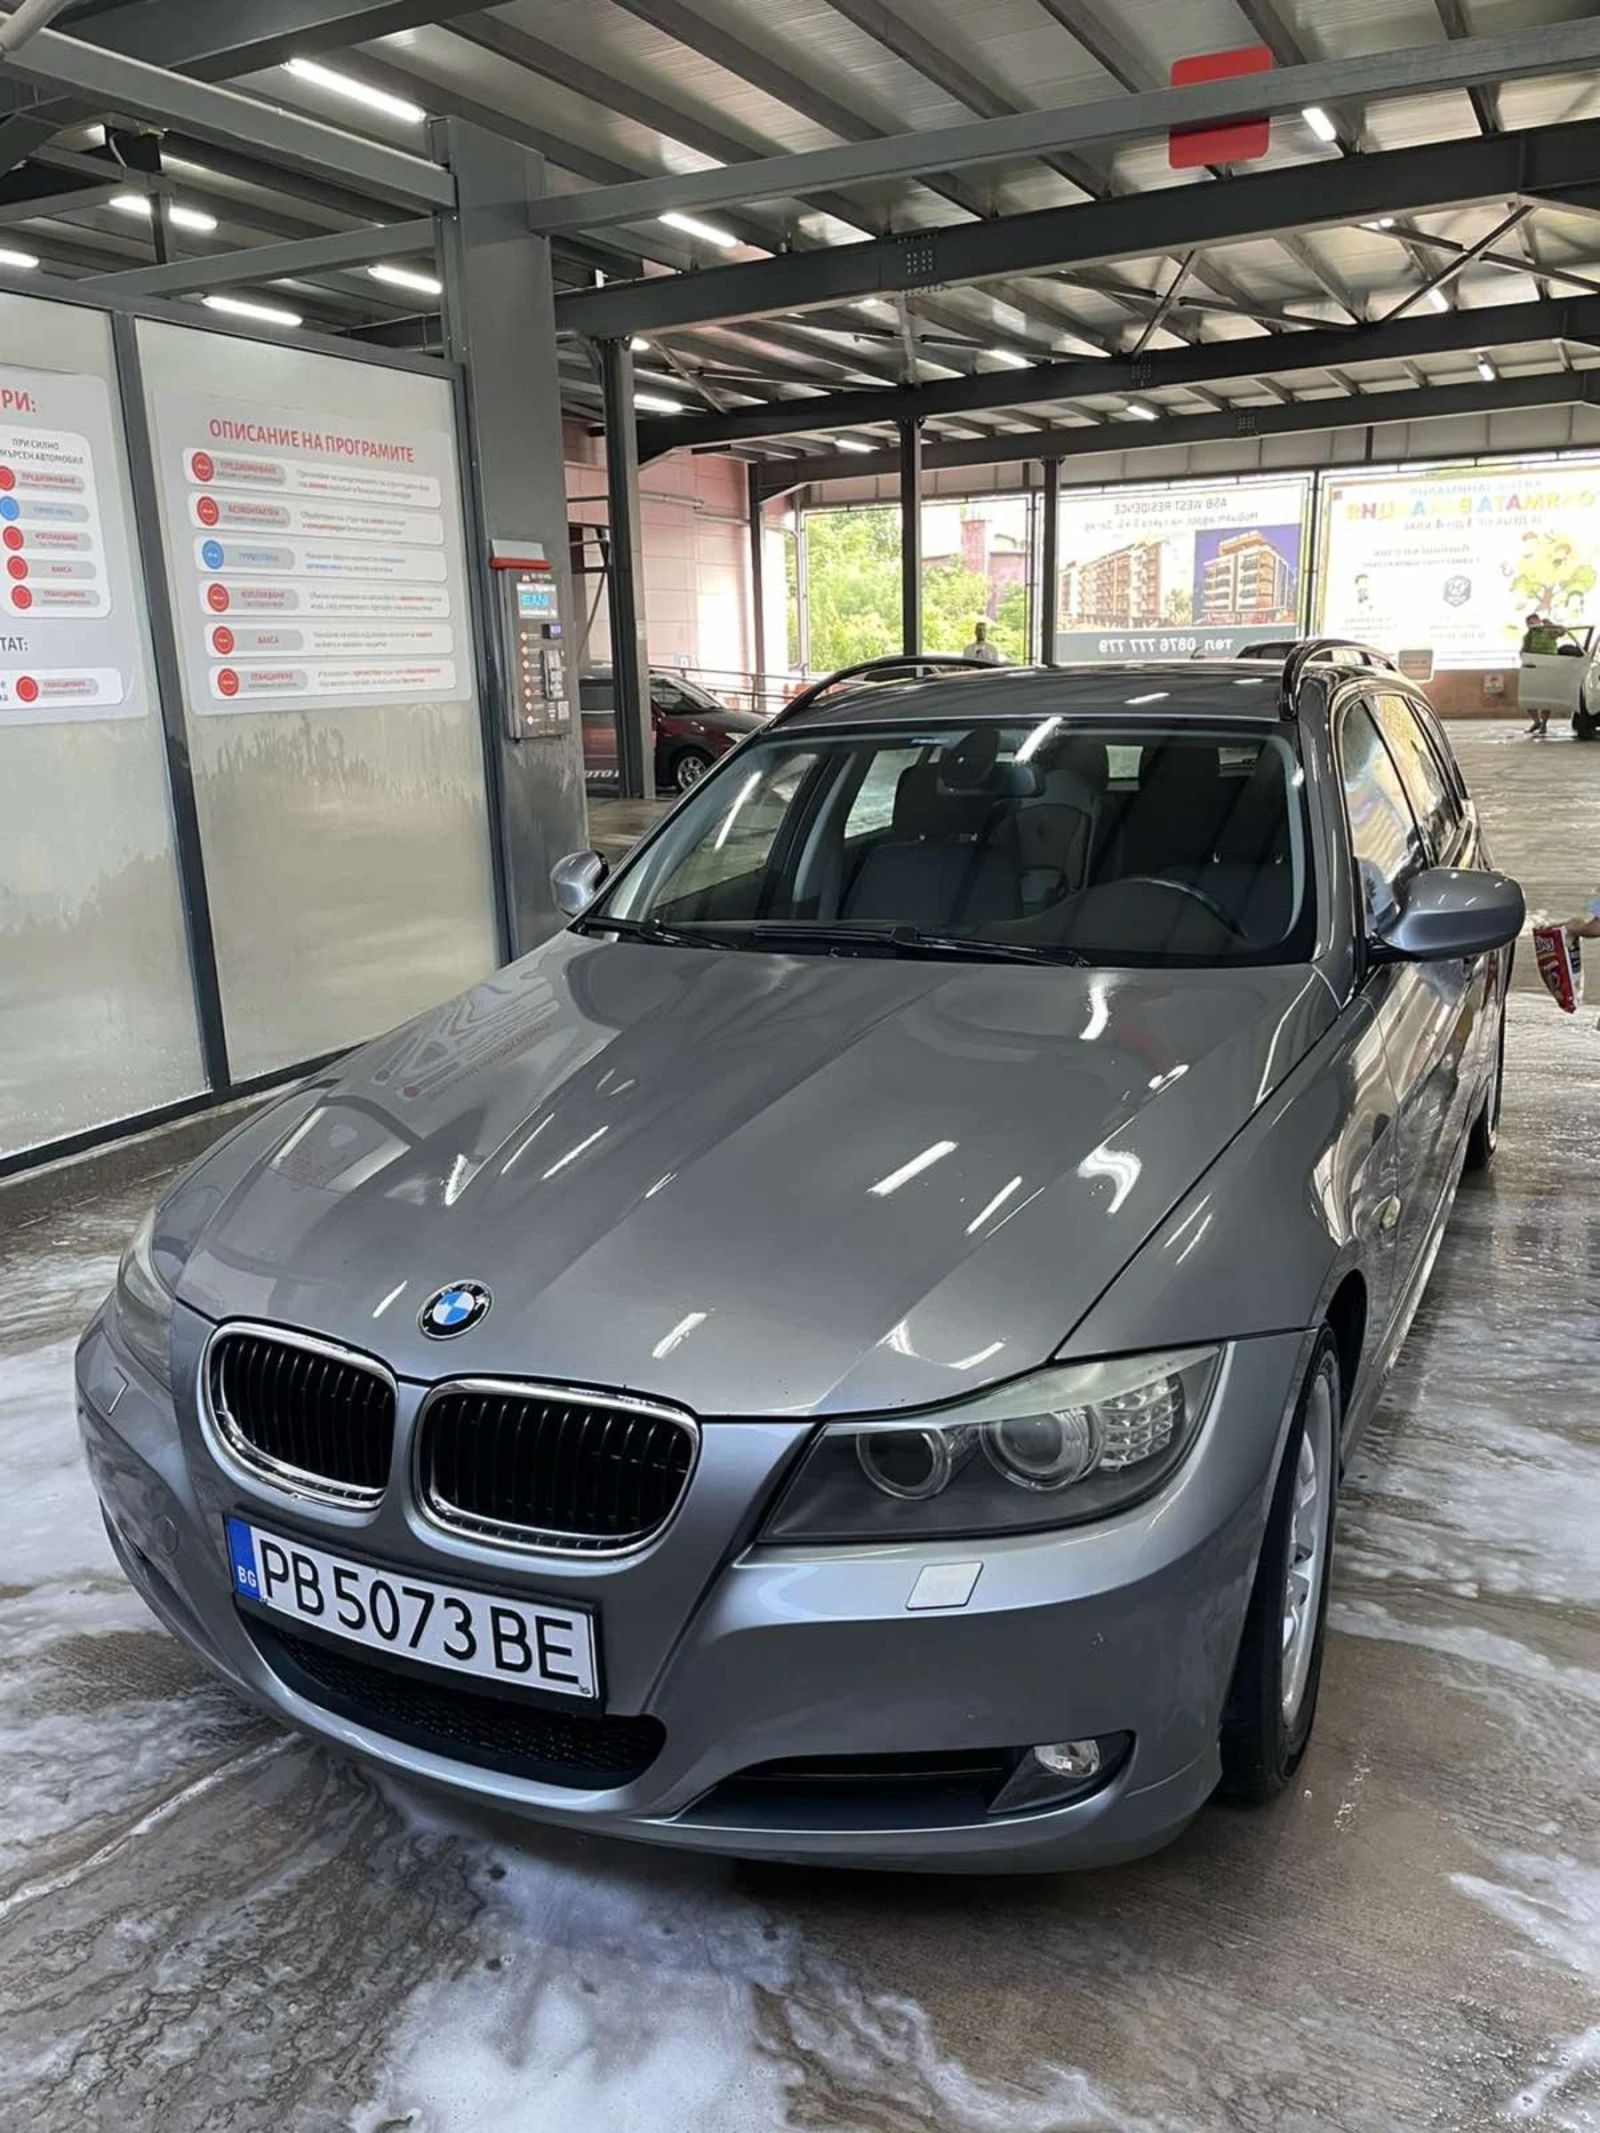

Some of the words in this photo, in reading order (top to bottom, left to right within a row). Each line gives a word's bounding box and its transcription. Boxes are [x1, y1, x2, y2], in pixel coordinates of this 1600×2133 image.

[209, 418, 299, 448] ОПИСАНИЕ
[302, 433, 323, 451] НА
[325, 436, 415, 463] ПРОГРАМИТЕ
[237, 1565, 257, 1588] BG
